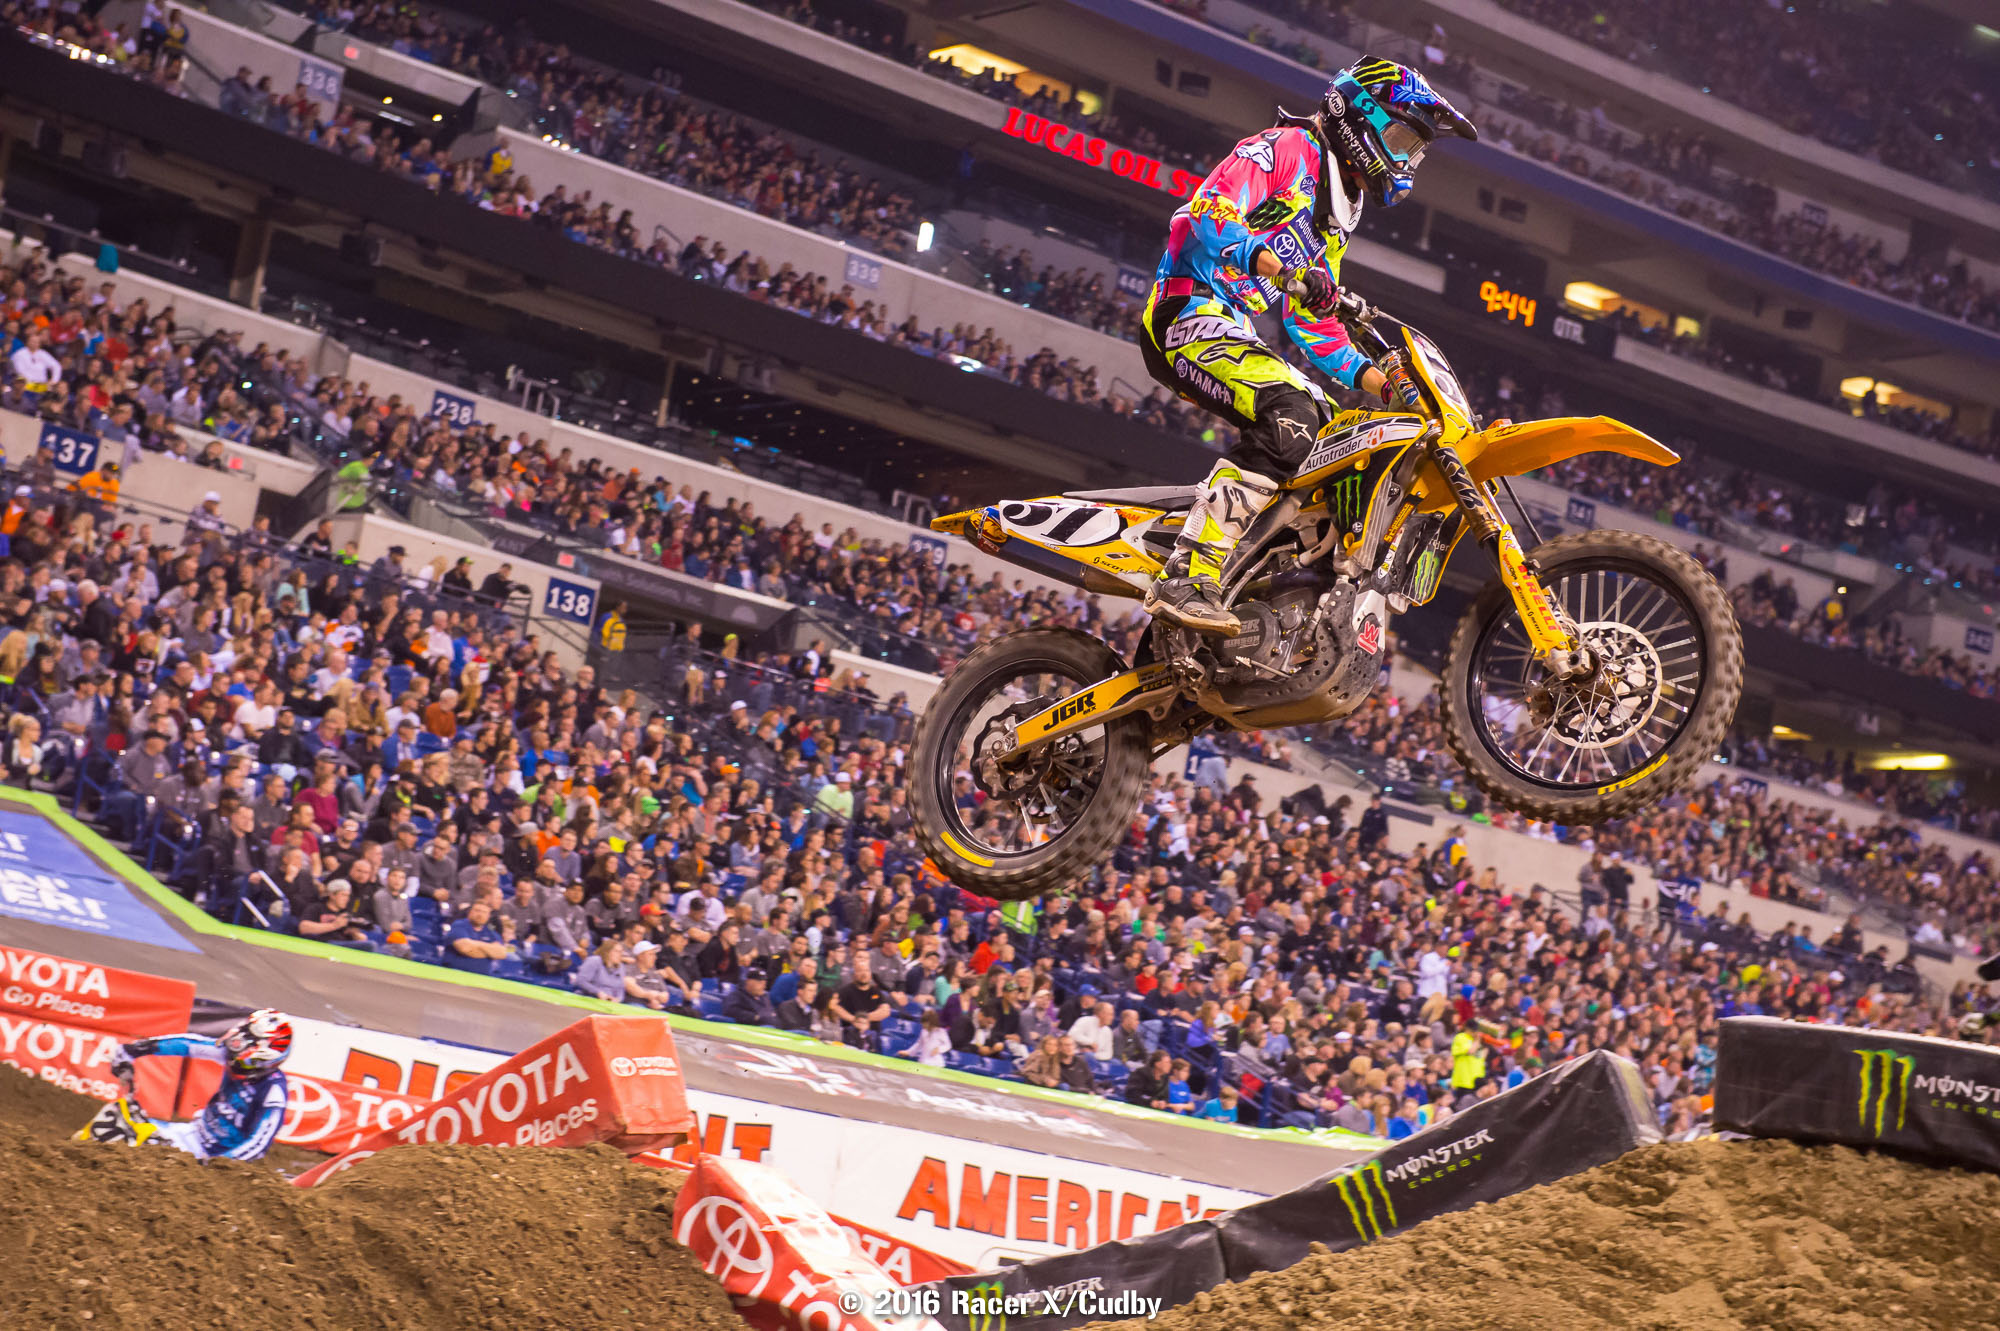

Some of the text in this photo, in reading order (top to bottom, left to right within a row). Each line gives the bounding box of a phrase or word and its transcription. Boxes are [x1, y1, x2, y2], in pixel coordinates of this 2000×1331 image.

[1001, 107, 1107, 166] LUCAS
[1110, 149, 1162, 189] OIL
[1338, 118, 1372, 168] MONSTER
[1295, 214, 1321, 253] Autotrader
[1479, 281, 1537, 327] 9:44
[1188, 365, 1232, 405] YAMAHA
[433, 397, 473, 425] 238
[1323, 411, 1372, 437] YAMAHA
[44, 432, 96, 468] 137
[1304, 438, 1362, 472] Autotrader
[547, 586, 591, 617] 138
[1042, 690, 1097, 731] JGR
[0, 950, 110, 999] YOTA
[3, 985, 106, 1020] Go Places
[398, 1042, 590, 1145] TOYOTA
[515, 1097, 598, 1146] Places
[1385, 1128, 1495, 1183] MONSTER
[1407, 1152, 1483, 1190] ENERGY
